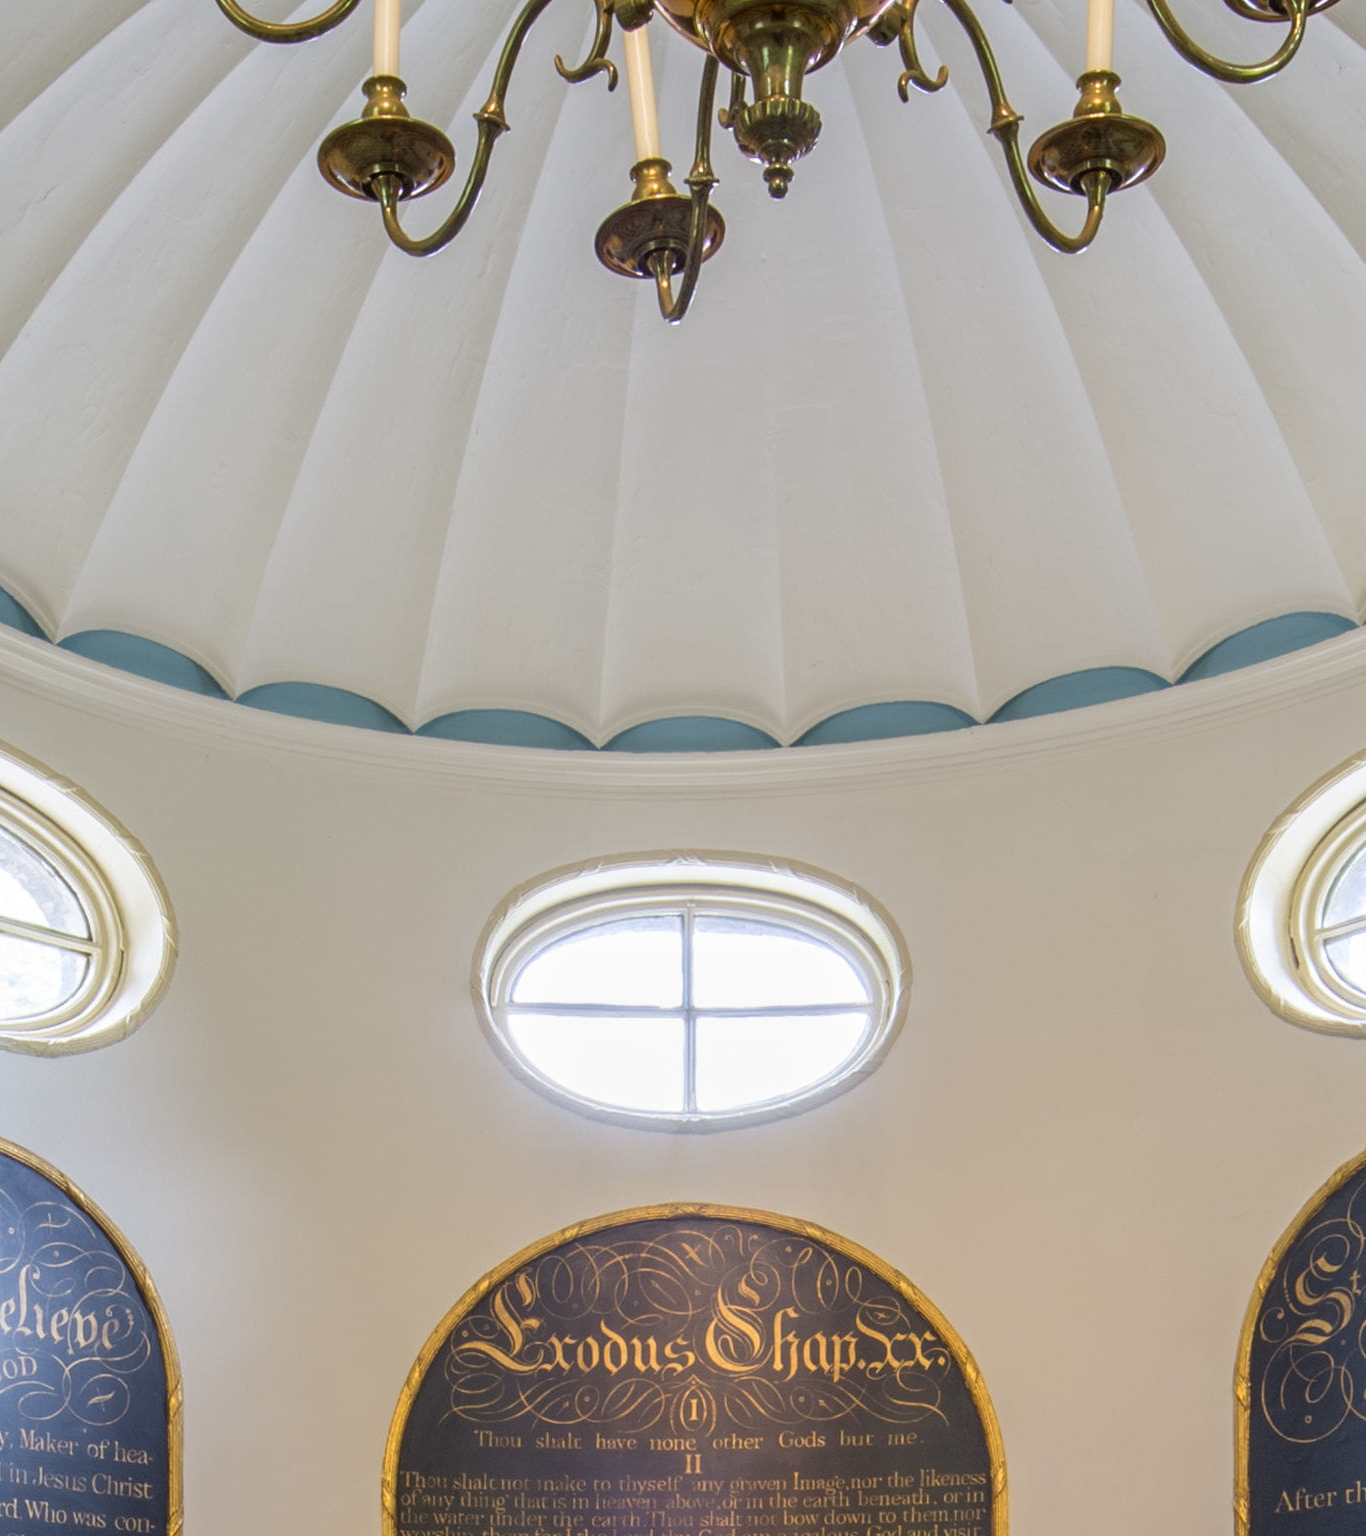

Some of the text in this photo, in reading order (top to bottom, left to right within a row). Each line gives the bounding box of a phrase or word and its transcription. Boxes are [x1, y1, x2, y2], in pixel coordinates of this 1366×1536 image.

[449, 1266, 696, 1381] Exodus
[474, 1430, 521, 1448] Thou
[536, 1432, 582, 1449] shalt
[596, 1432, 637, 1450] have
[650, 1438, 696, 1451] none
[712, 1433, 763, 1450] other
[778, 1431, 826, 1448] Gods
[840, 1430, 874, 1446] but
[684, 1454, 703, 1474] II
[1274, 1488, 1337, 1513] After
